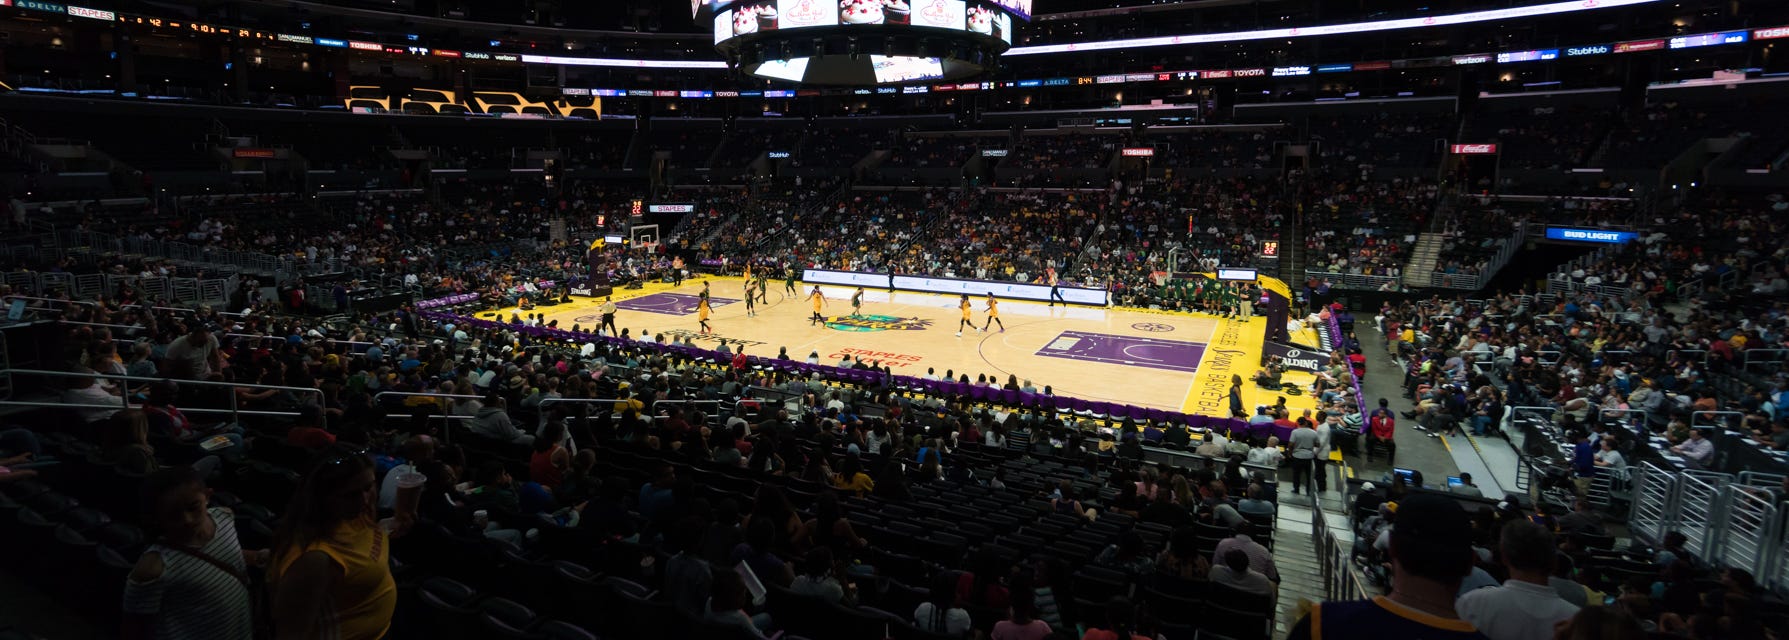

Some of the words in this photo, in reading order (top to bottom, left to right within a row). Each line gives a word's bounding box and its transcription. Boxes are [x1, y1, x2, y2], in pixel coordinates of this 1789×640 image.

[29, 2, 64, 12] DELTA
[69, 7, 113, 20] STAPLES
[191, 24, 208, 32] 9:10
[350, 42, 382, 50] TOSHIBA
[1568, 46, 1607, 56] StubHub
[571, 288, 591, 296] SPALDING
[840, 348, 922, 361] STAPLES
[828, 353, 912, 367] Cnter
[1280, 354, 1318, 370] ALDING
